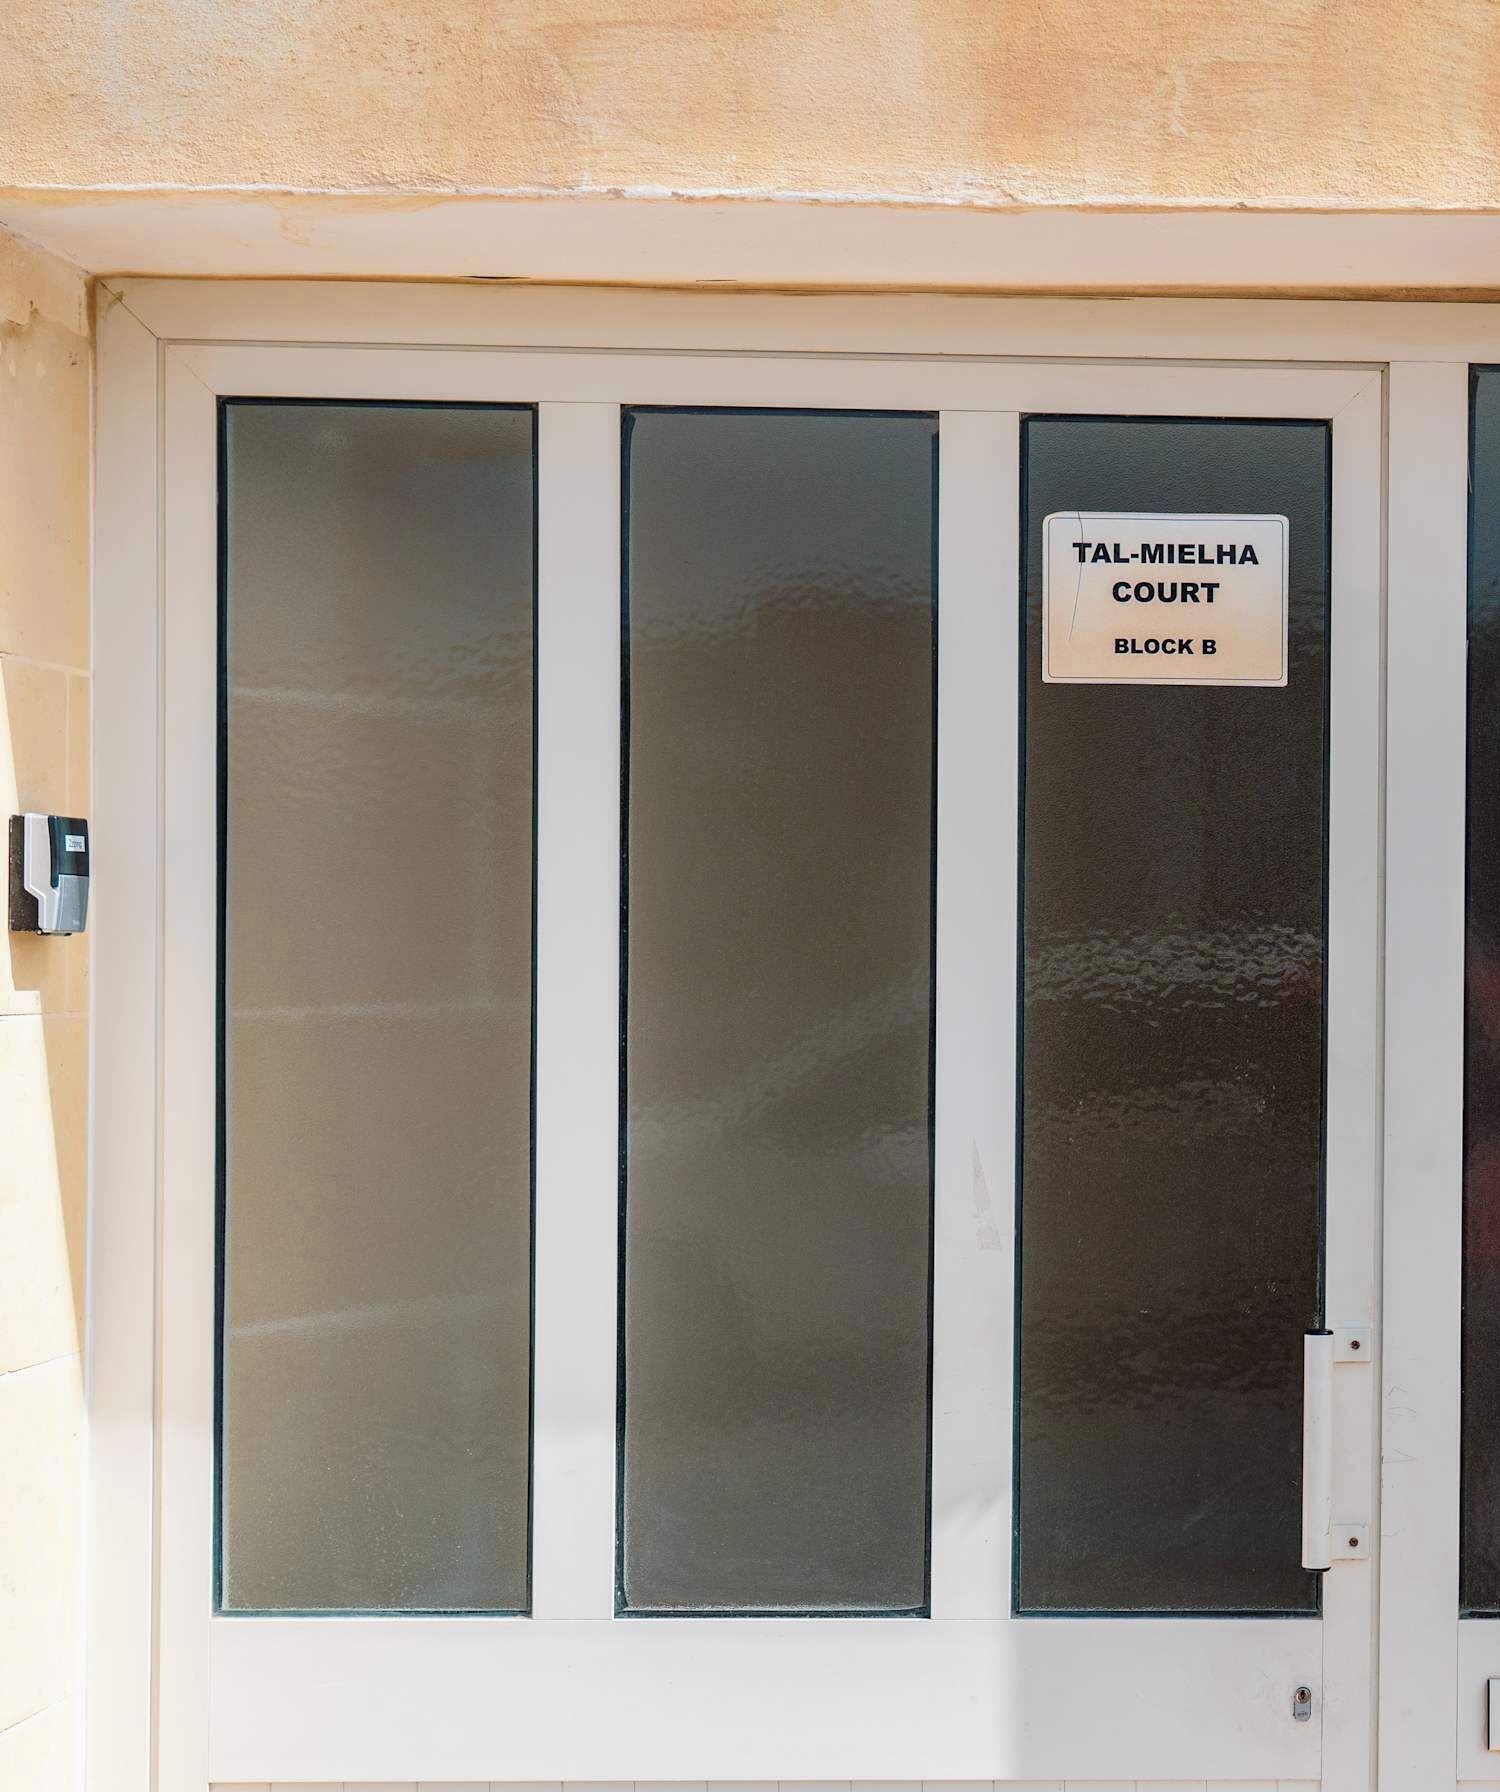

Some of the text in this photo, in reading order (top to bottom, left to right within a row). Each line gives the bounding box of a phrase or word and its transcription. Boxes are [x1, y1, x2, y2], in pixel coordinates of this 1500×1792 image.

[1072, 542, 1259, 565] TAL-MIELHA
[1112, 581, 1220, 603] COURT
[1114, 638, 1217, 655] BLOCK B
